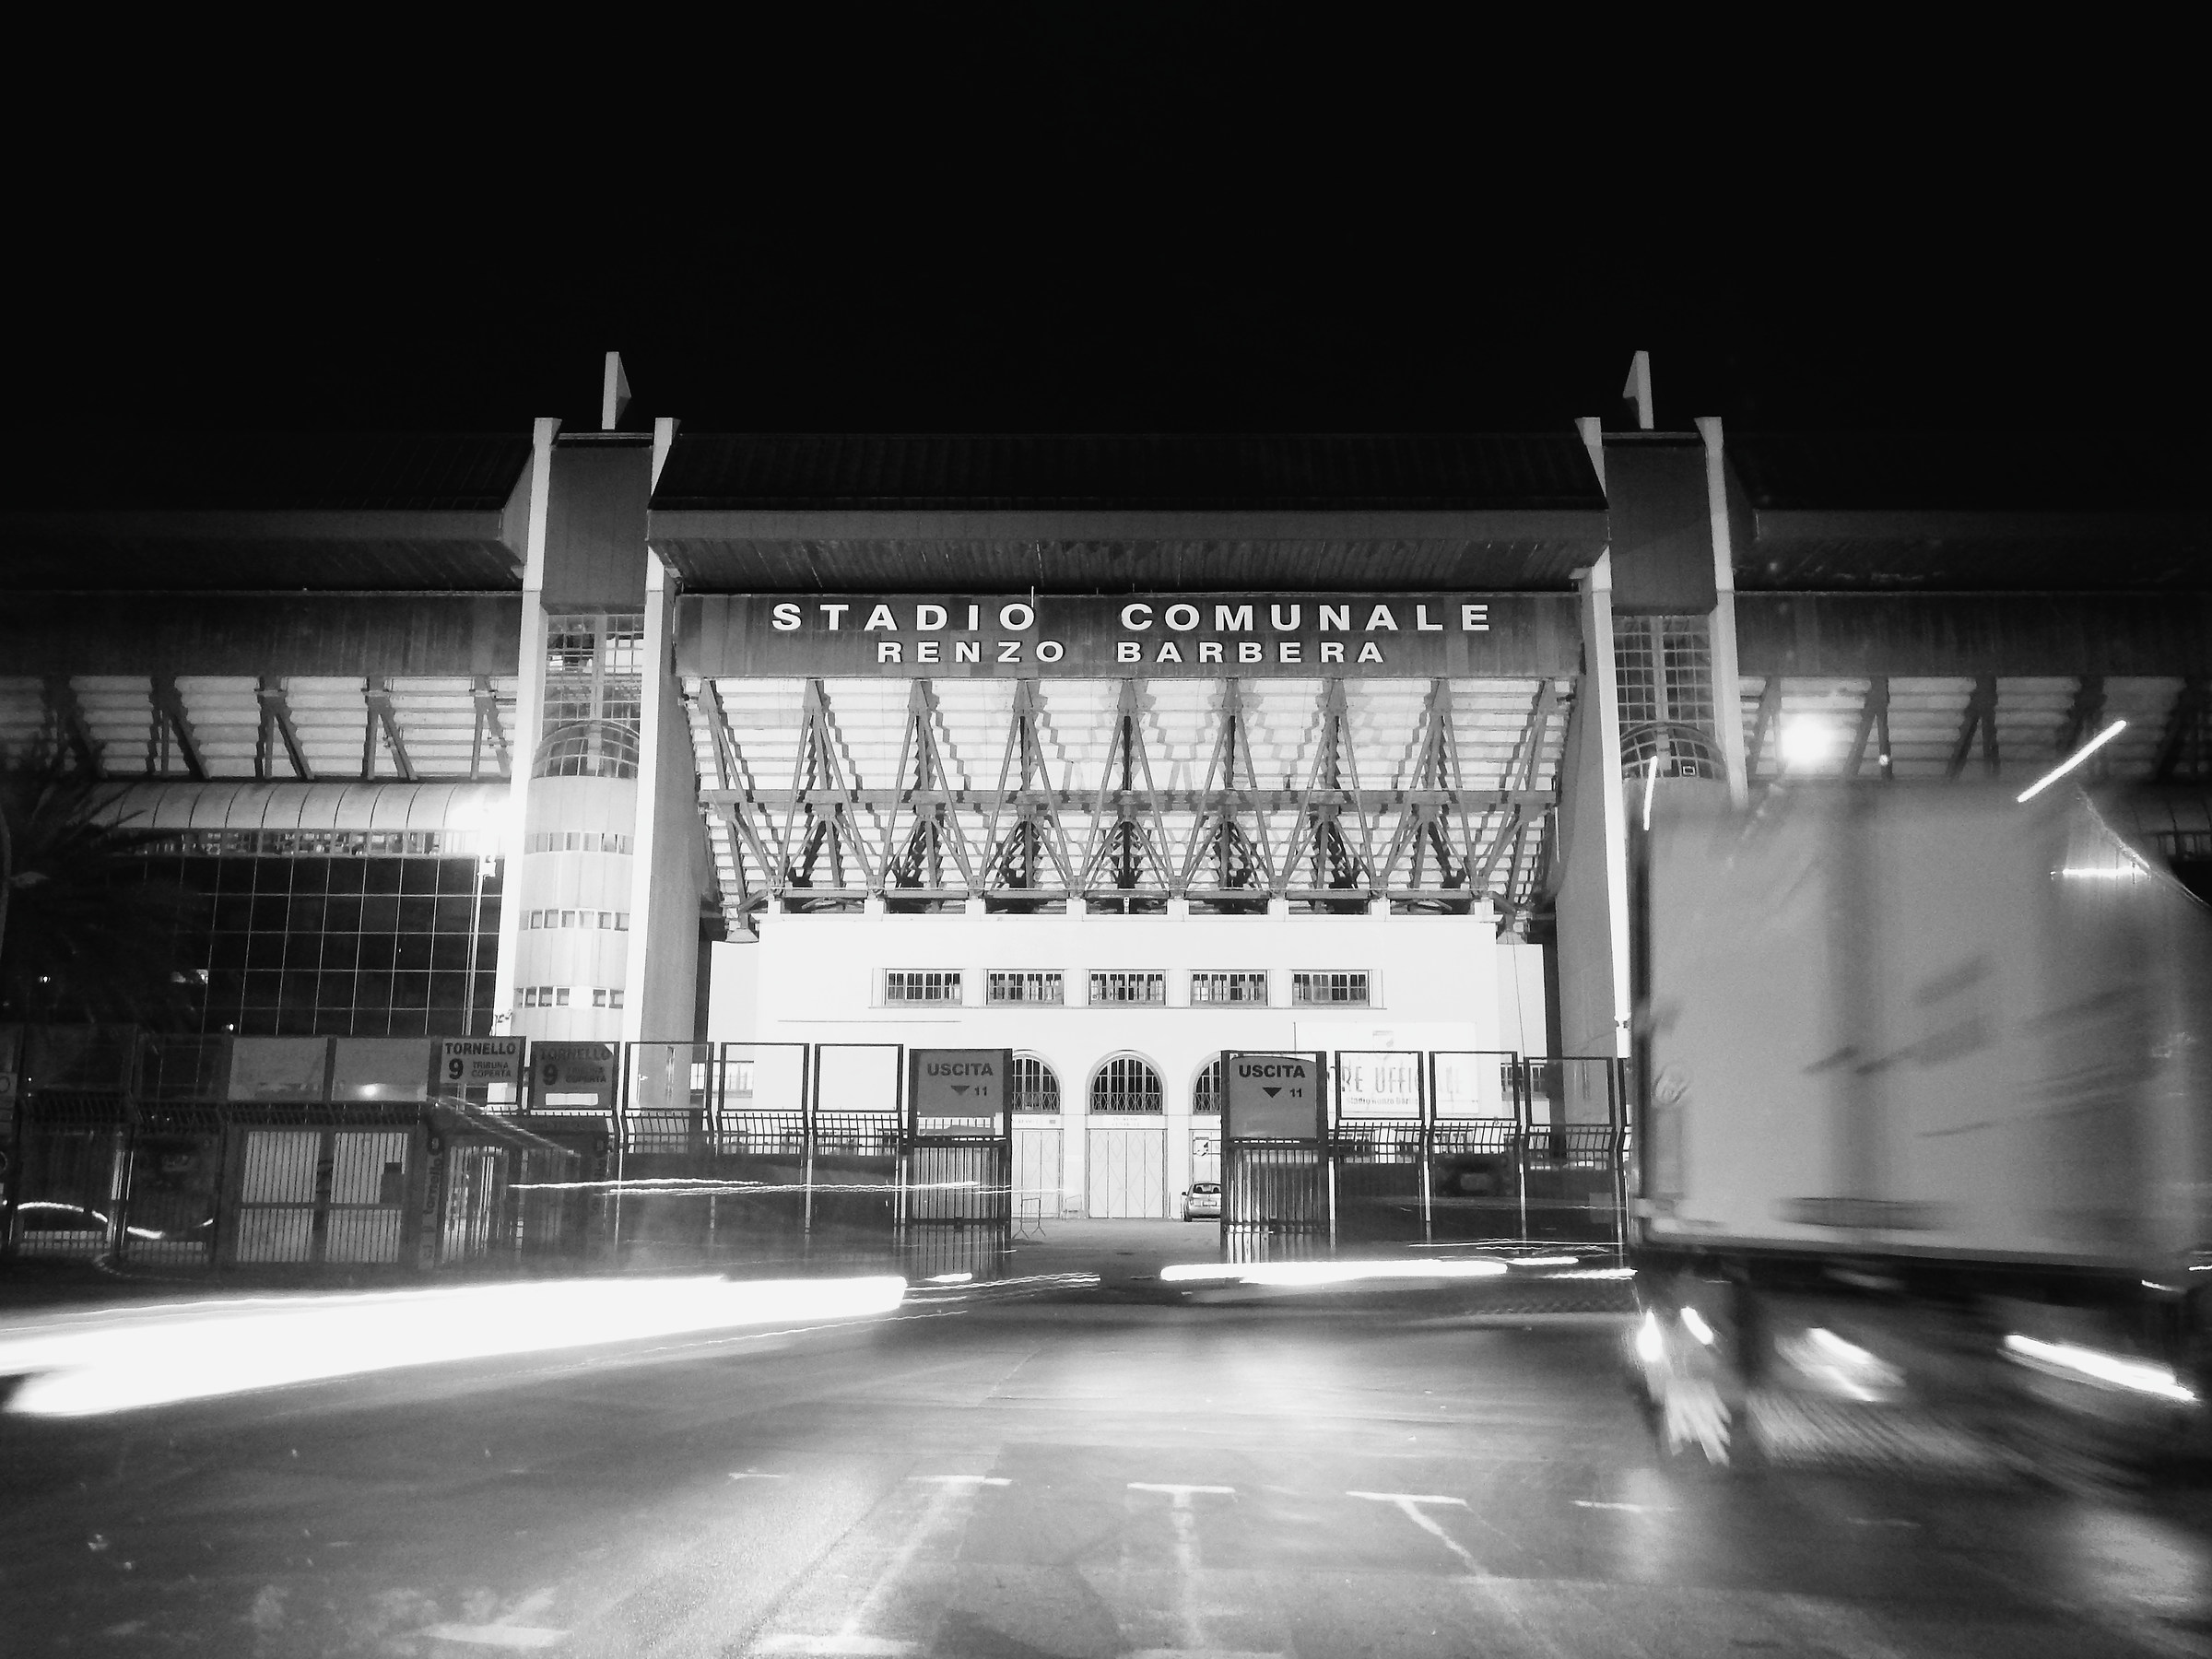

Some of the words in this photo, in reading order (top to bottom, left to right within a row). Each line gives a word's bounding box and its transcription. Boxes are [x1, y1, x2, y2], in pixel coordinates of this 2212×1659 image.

[771, 603, 1035, 631] STADIO
[1120, 603, 1490, 631] COMUNALE
[877, 641, 1065, 663] RENZO
[1116, 641, 1384, 663] BARBERA
[445, 1041, 516, 1055] TORNELLO
[540, 1047, 610, 1060] TORNELLO
[448, 1058, 465, 1080] 9
[472, 1061, 509, 1070] TRIBUNA
[926, 1062, 994, 1077] USCITA
[1238, 1064, 1305, 1078] USCITA
[471, 1069, 512, 1078] COPERTA
[542, 1063, 559, 1086] 9
[973, 1086, 988, 1097] 11
[1289, 1088, 1303, 1099] 11
